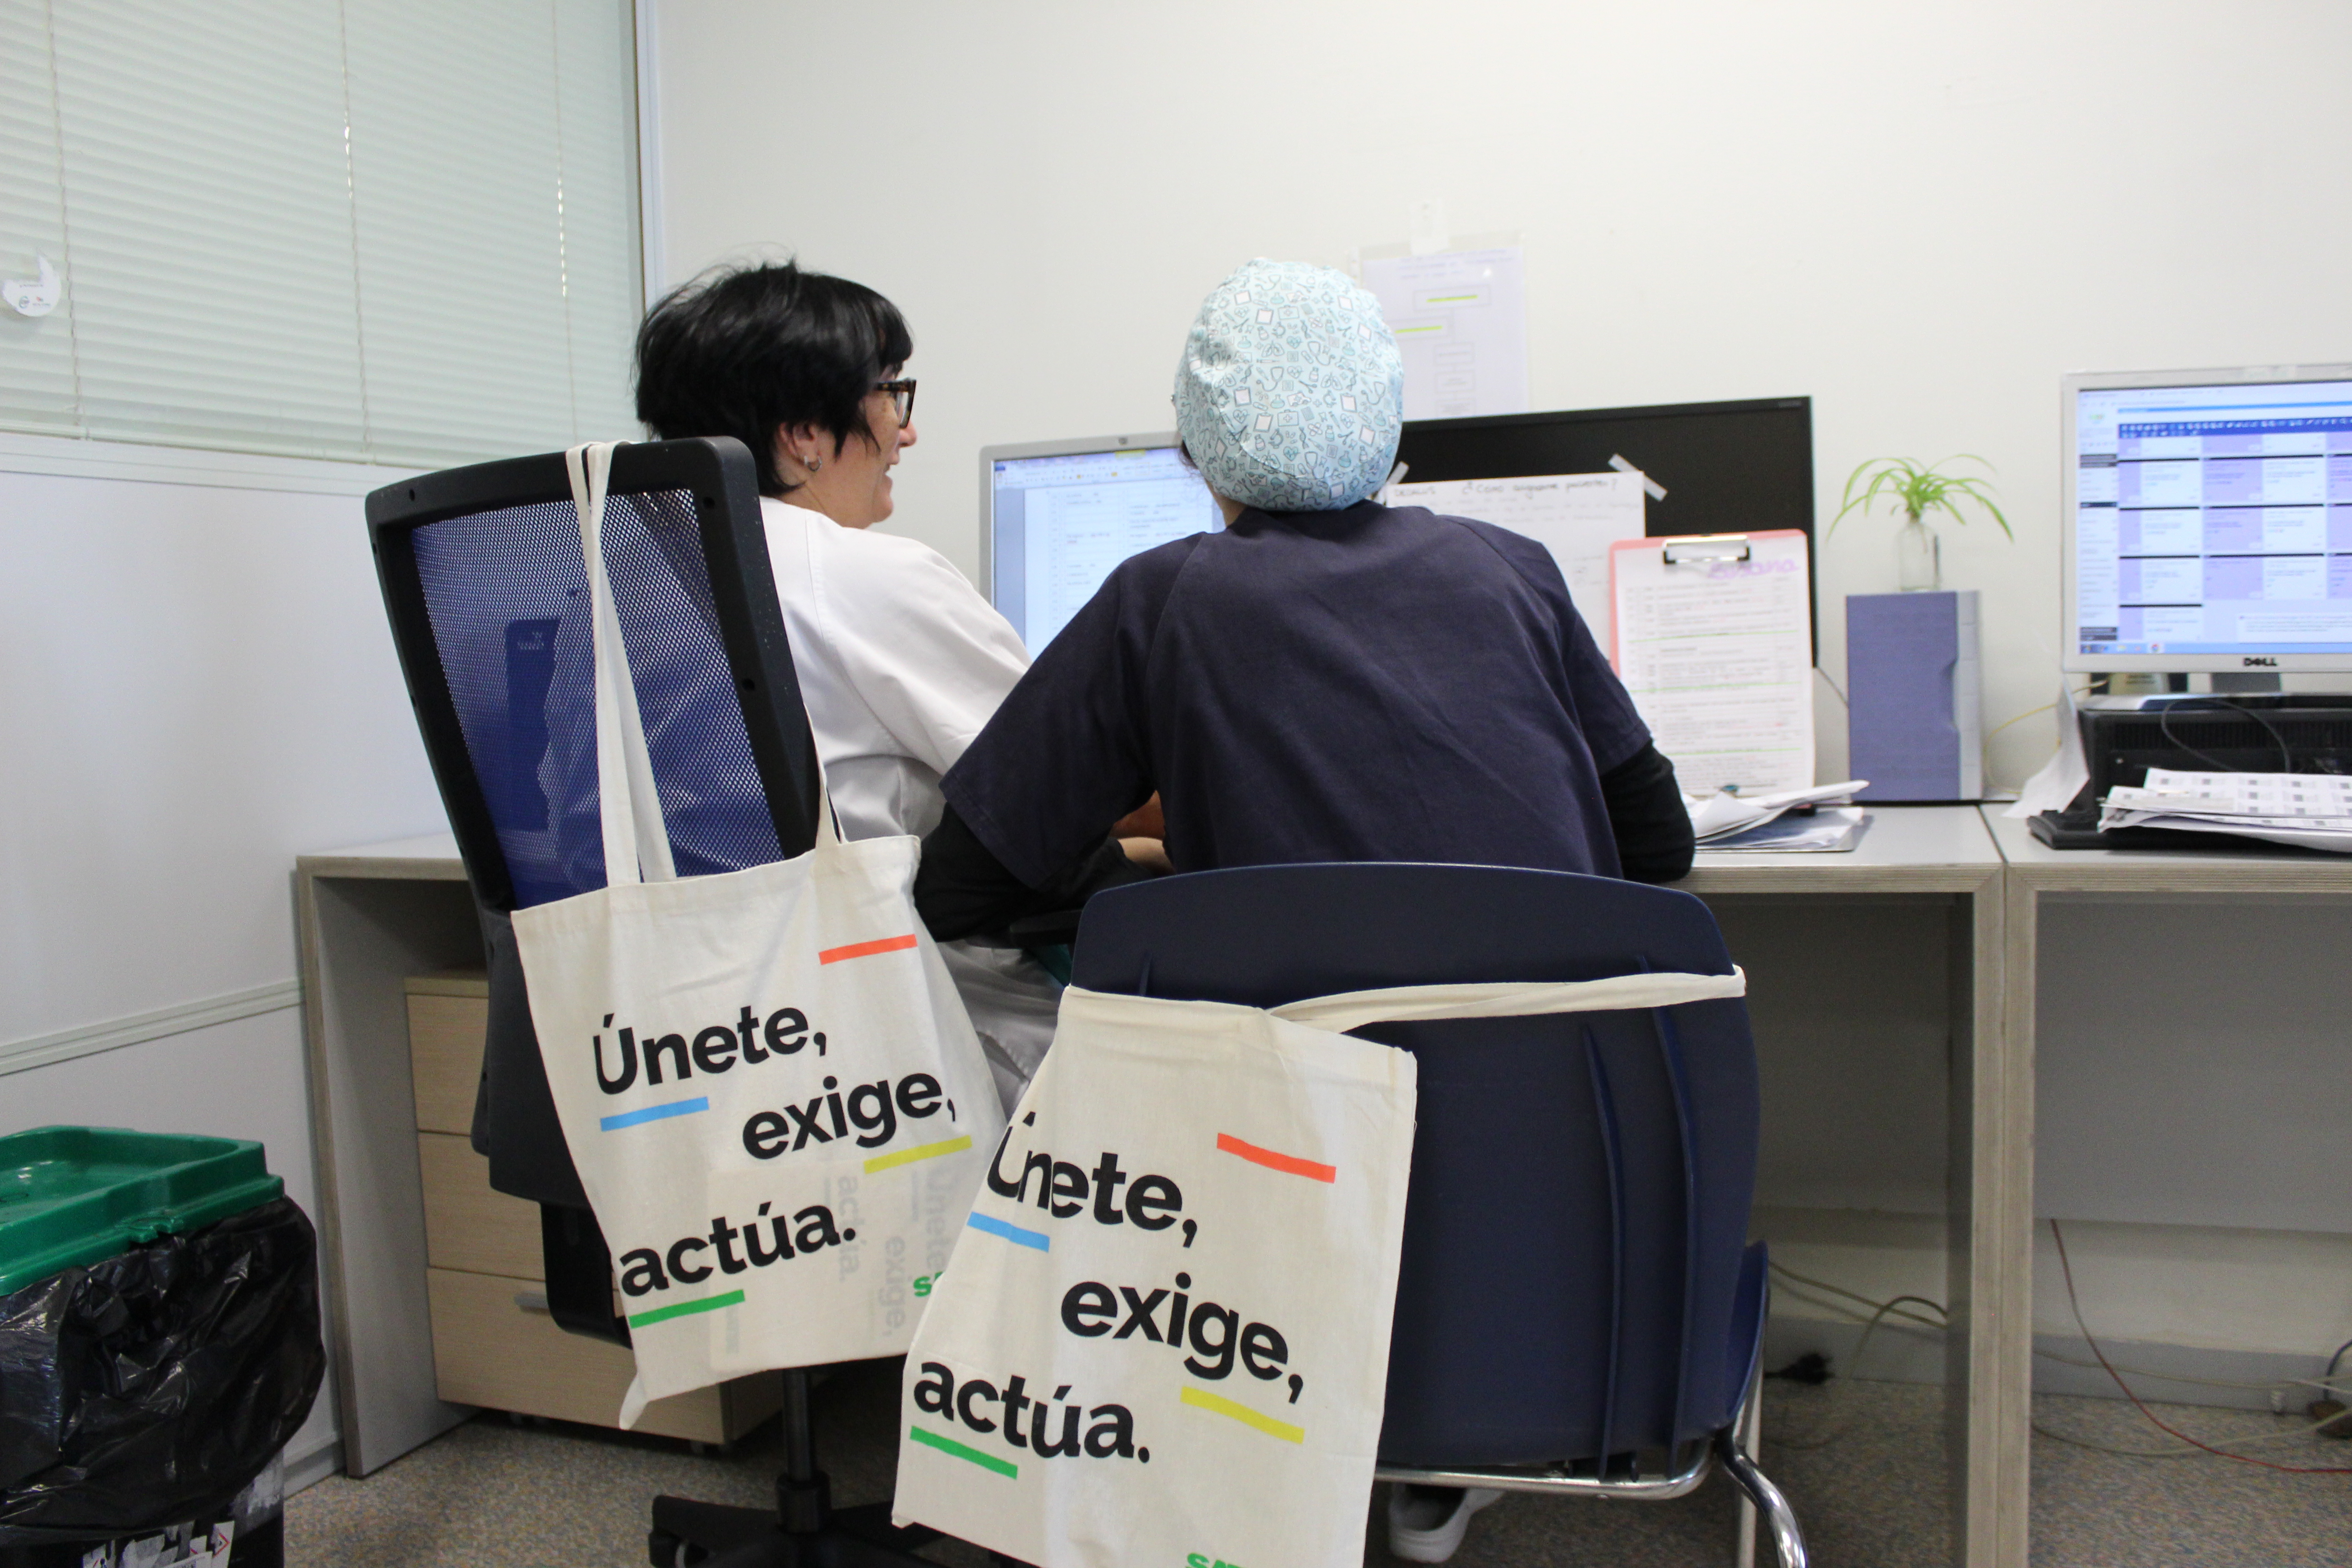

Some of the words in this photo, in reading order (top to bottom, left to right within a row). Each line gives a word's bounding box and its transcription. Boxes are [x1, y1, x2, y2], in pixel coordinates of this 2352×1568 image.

[2243, 657, 2277, 666] DELL
[593, 1005, 827, 1095] Únete,
[742, 1072, 956, 1160] exige,
[986, 1111, 1197, 1249] Únete,
[619, 1201, 857, 1298] actúa.
[1061, 1272, 1303, 1405] exige,
[913, 1361, 1150, 1463] actúa.
